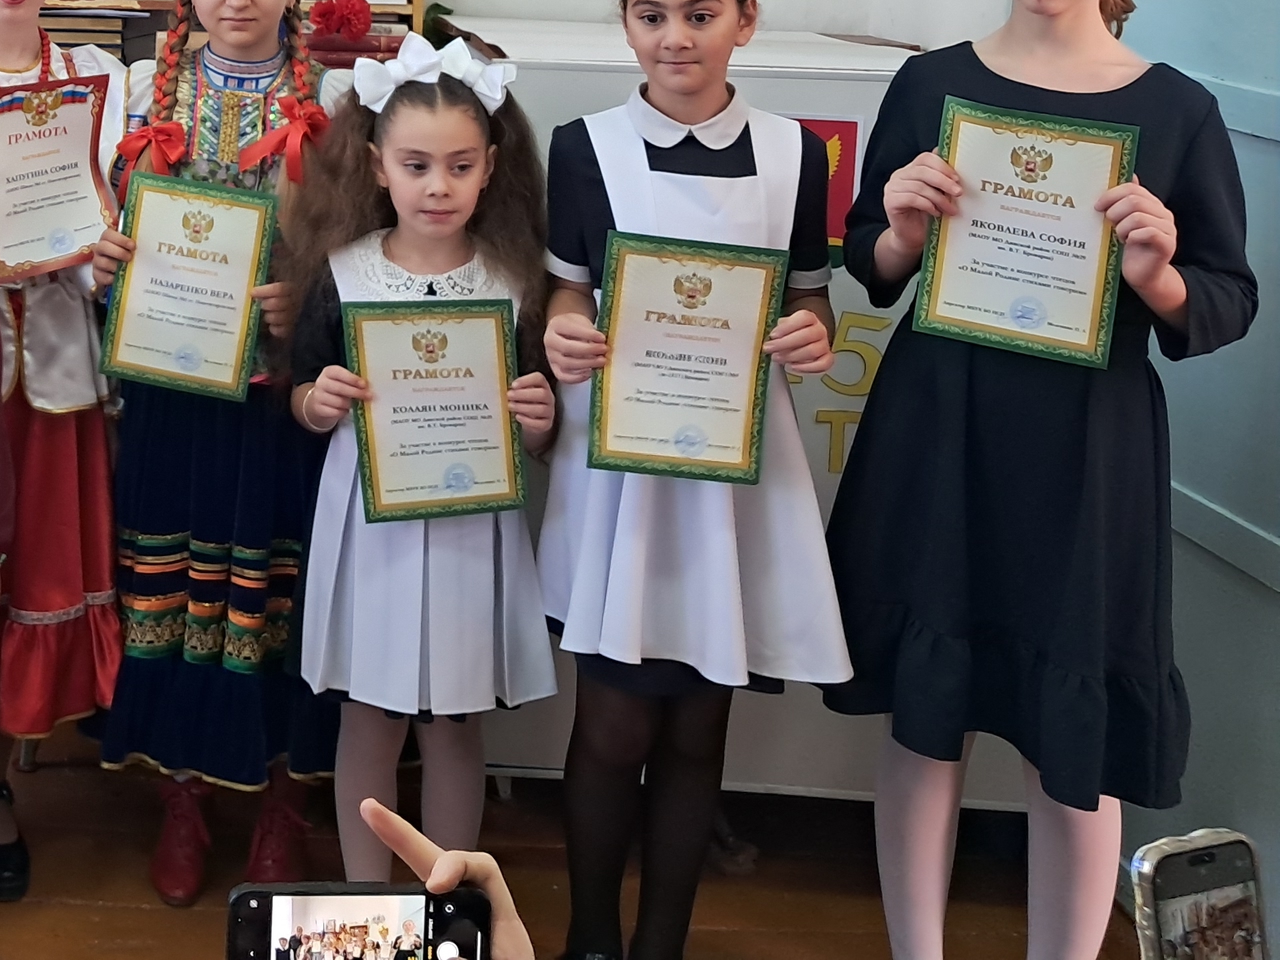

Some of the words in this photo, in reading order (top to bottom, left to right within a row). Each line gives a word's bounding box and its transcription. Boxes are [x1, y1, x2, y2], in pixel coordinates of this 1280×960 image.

[8, 125, 68, 145] ГРАМОТА
[980, 179, 1076, 209] ГРАМОТА
[970, 218, 1036, 239] ЯКОВЛЕВА
[1039, 232, 1086, 249] СОФИЯ
[156, 241, 229, 265] ГРАМОТА
[644, 310, 732, 330] ГРАМОТА
[786, 310, 892, 397] 5
[391, 366, 474, 380] ГРАМОТА
[439, 402, 489, 412] МОНИКА
